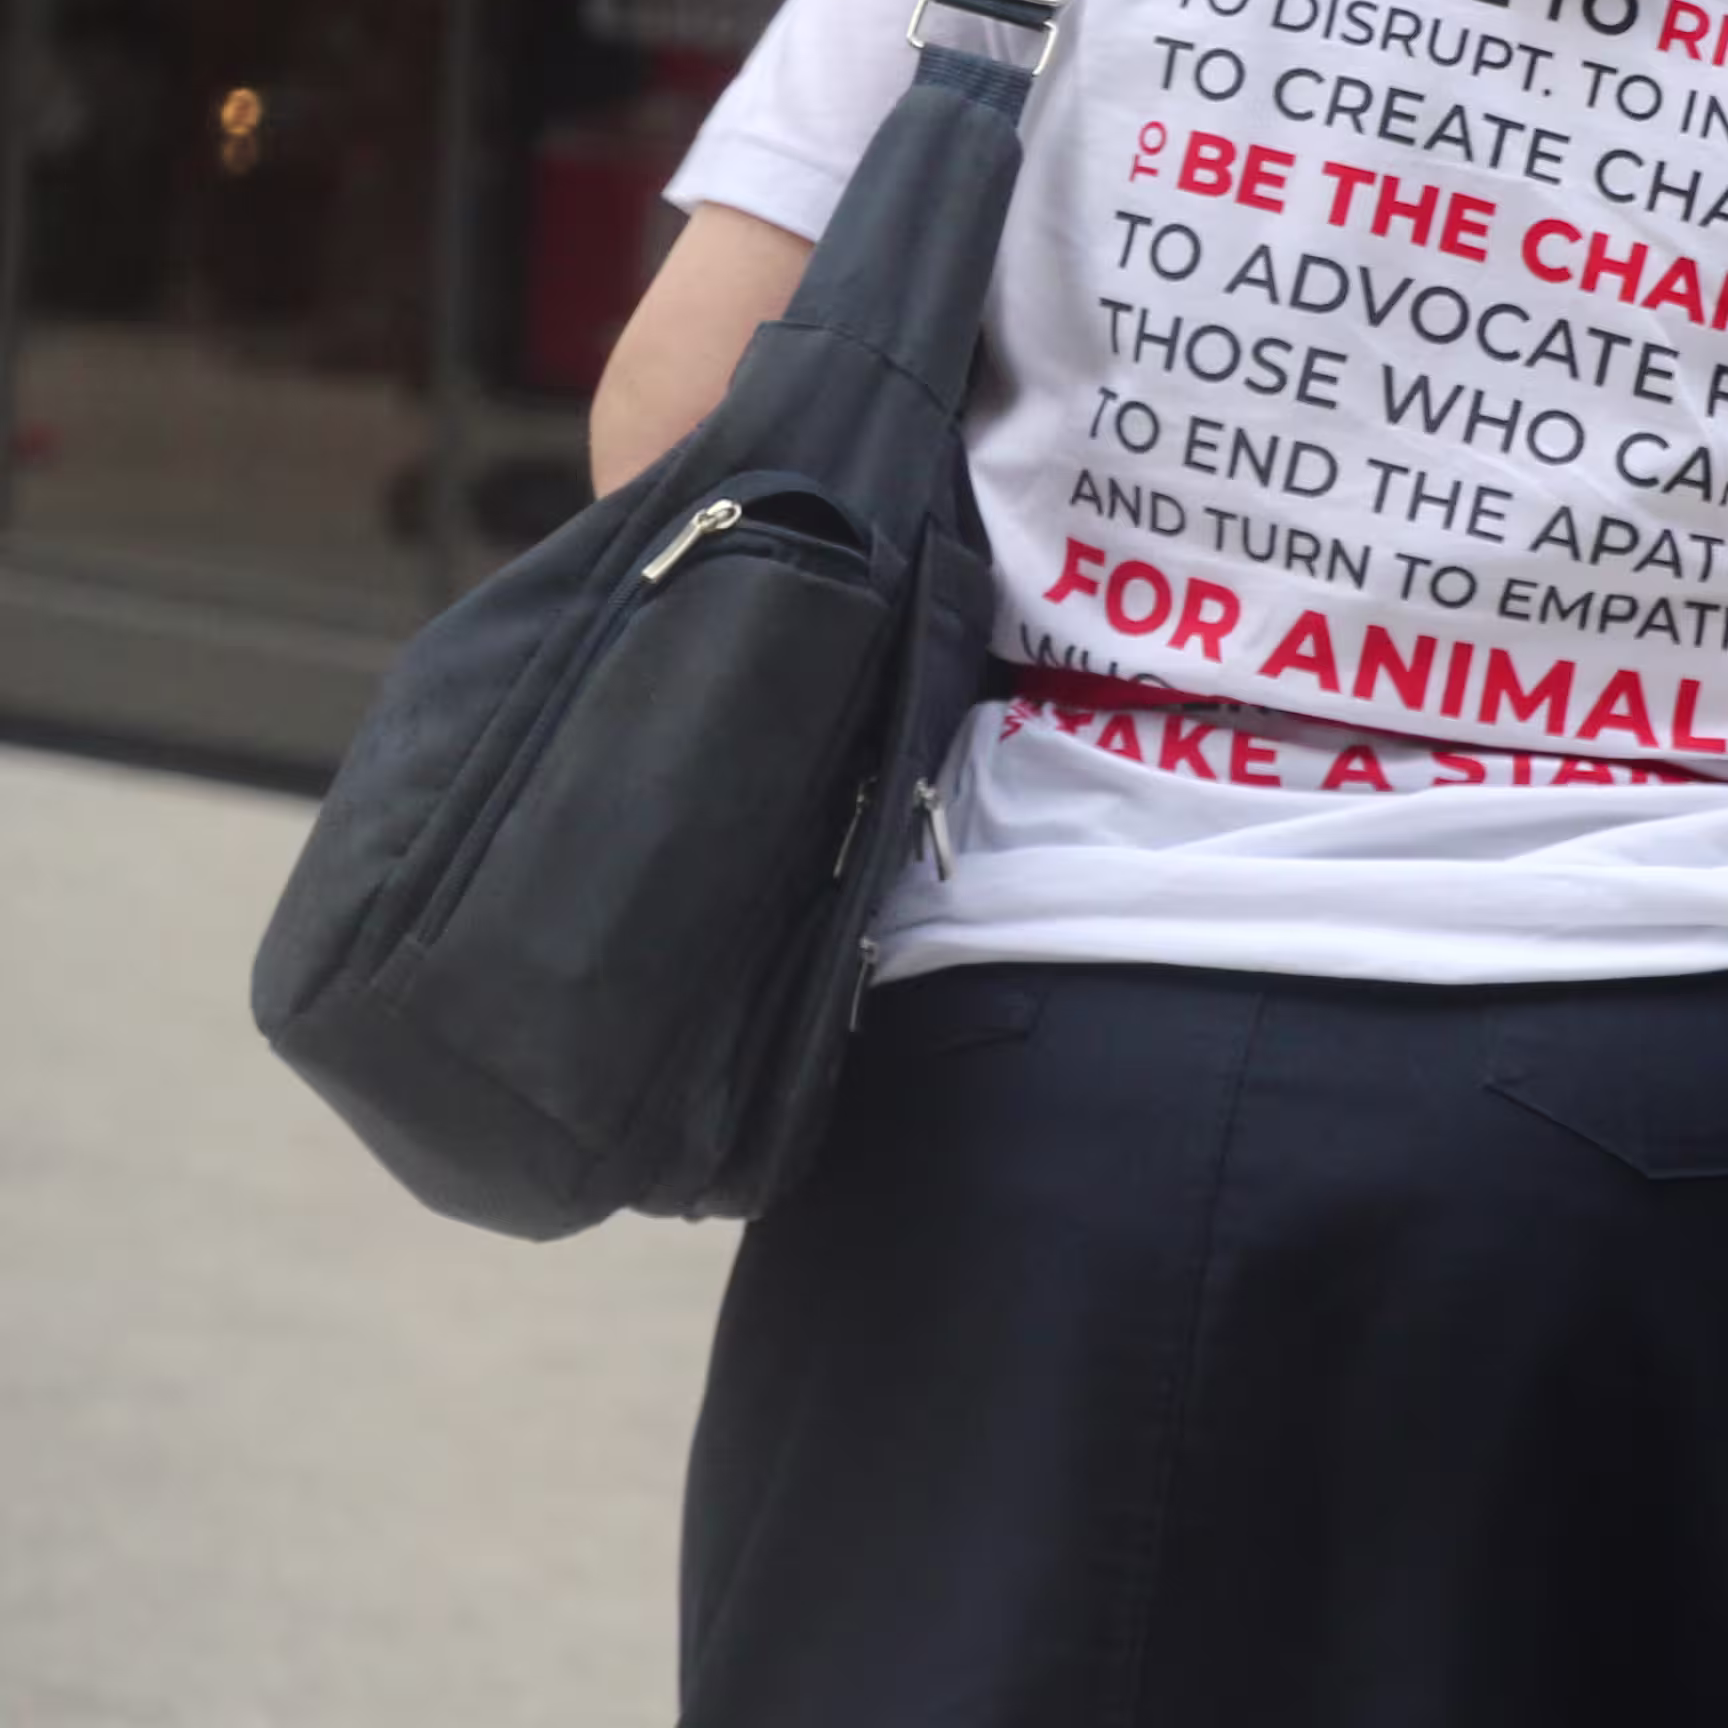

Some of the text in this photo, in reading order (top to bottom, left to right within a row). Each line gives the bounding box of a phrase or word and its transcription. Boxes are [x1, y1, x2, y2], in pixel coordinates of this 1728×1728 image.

[1155, 36, 1245, 101] TO
[1273, 68, 1571, 185] CREATE
[1582, 60, 1663, 121] TO
[1130, 121, 1166, 181] TO
[1177, 130, 1296, 214] BE
[1322, 161, 1496, 263] THE
[1116, 210, 1201, 281] TO
[1224, 244, 1680, 404] ADVOCATE
[1100, 298, 1348, 410] THOSE
[1382, 364, 1585, 465] WHO
[1090, 387, 1161, 454] TO
[1183, 416, 1338, 497] END
[1367, 458, 1513, 543] THE
[1043, 536, 1241, 662] FOR
[1069, 469, 1187, 537] AND
[1204, 507, 1371, 589] TURN
[1395, 553, 1478, 609] TO
